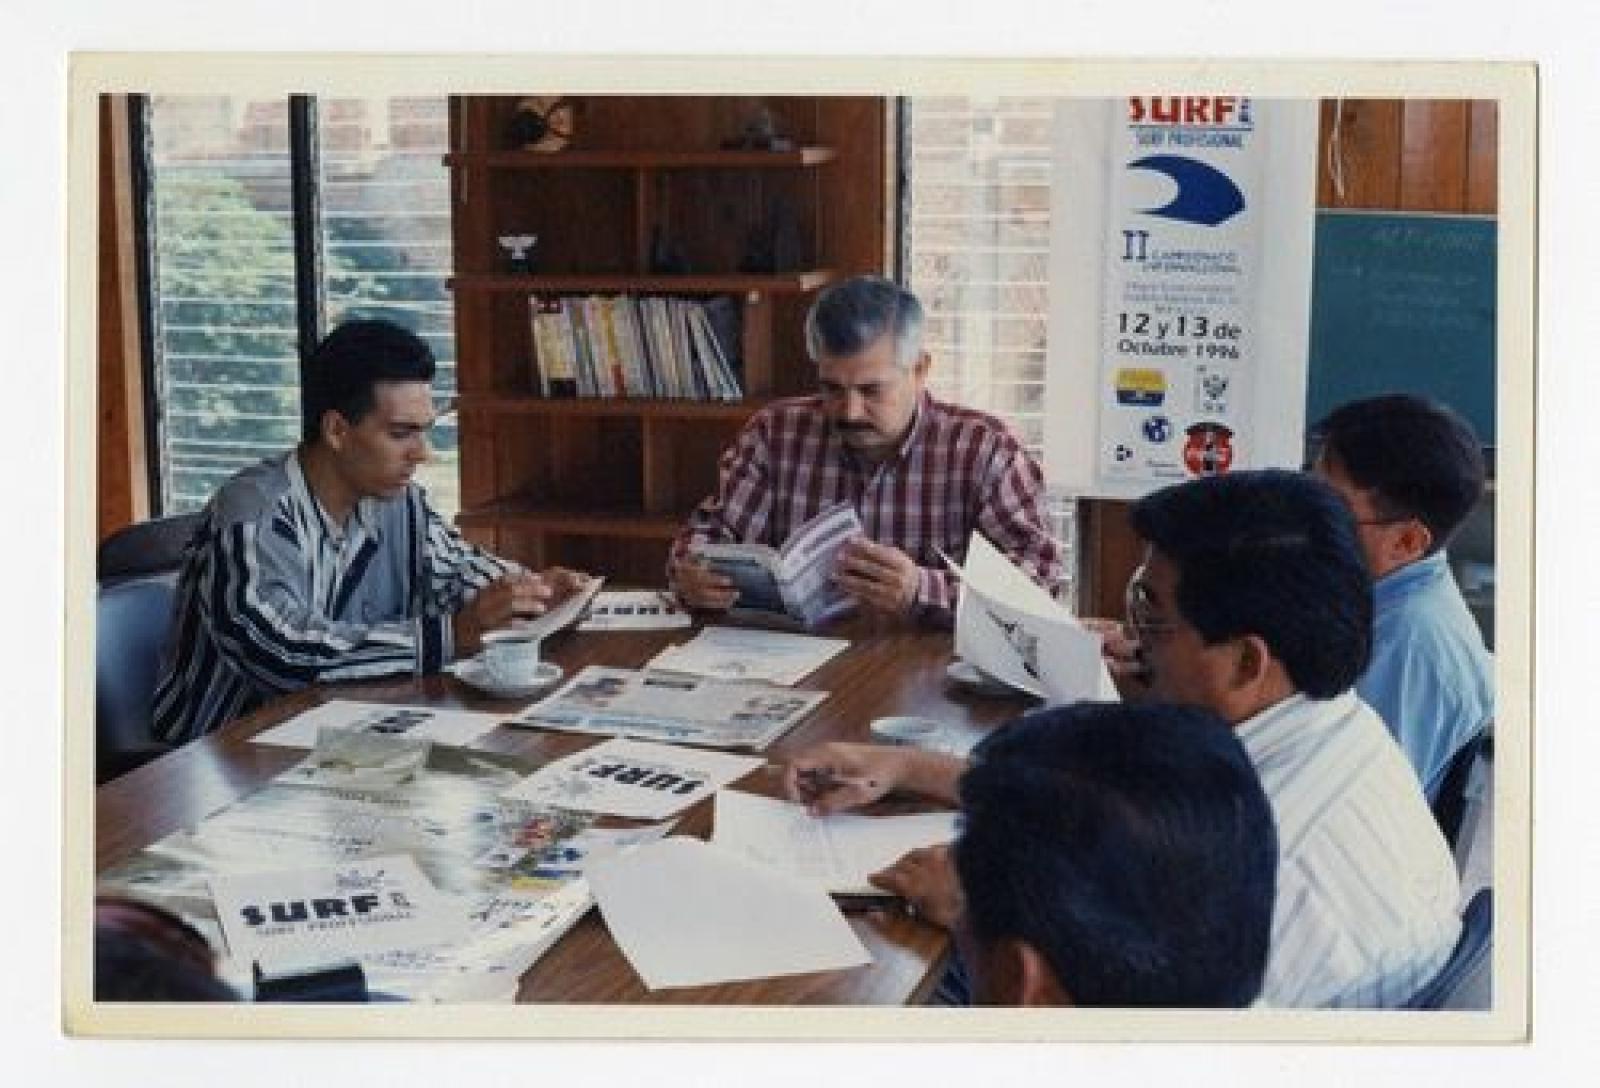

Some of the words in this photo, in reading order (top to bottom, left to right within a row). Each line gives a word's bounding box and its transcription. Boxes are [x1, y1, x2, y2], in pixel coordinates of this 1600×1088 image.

[1129, 95, 1236, 122] SURF
[1121, 230, 1149, 262] II
[1118, 312, 1150, 334] 12
[1156, 322, 1170, 340] y
[1176, 315, 1208, 337] 13
[1213, 322, 1242, 340] de
[1117, 338, 1188, 357] Octubre
[1195, 342, 1240, 359] 1996
[239, 894, 379, 927] SURF
